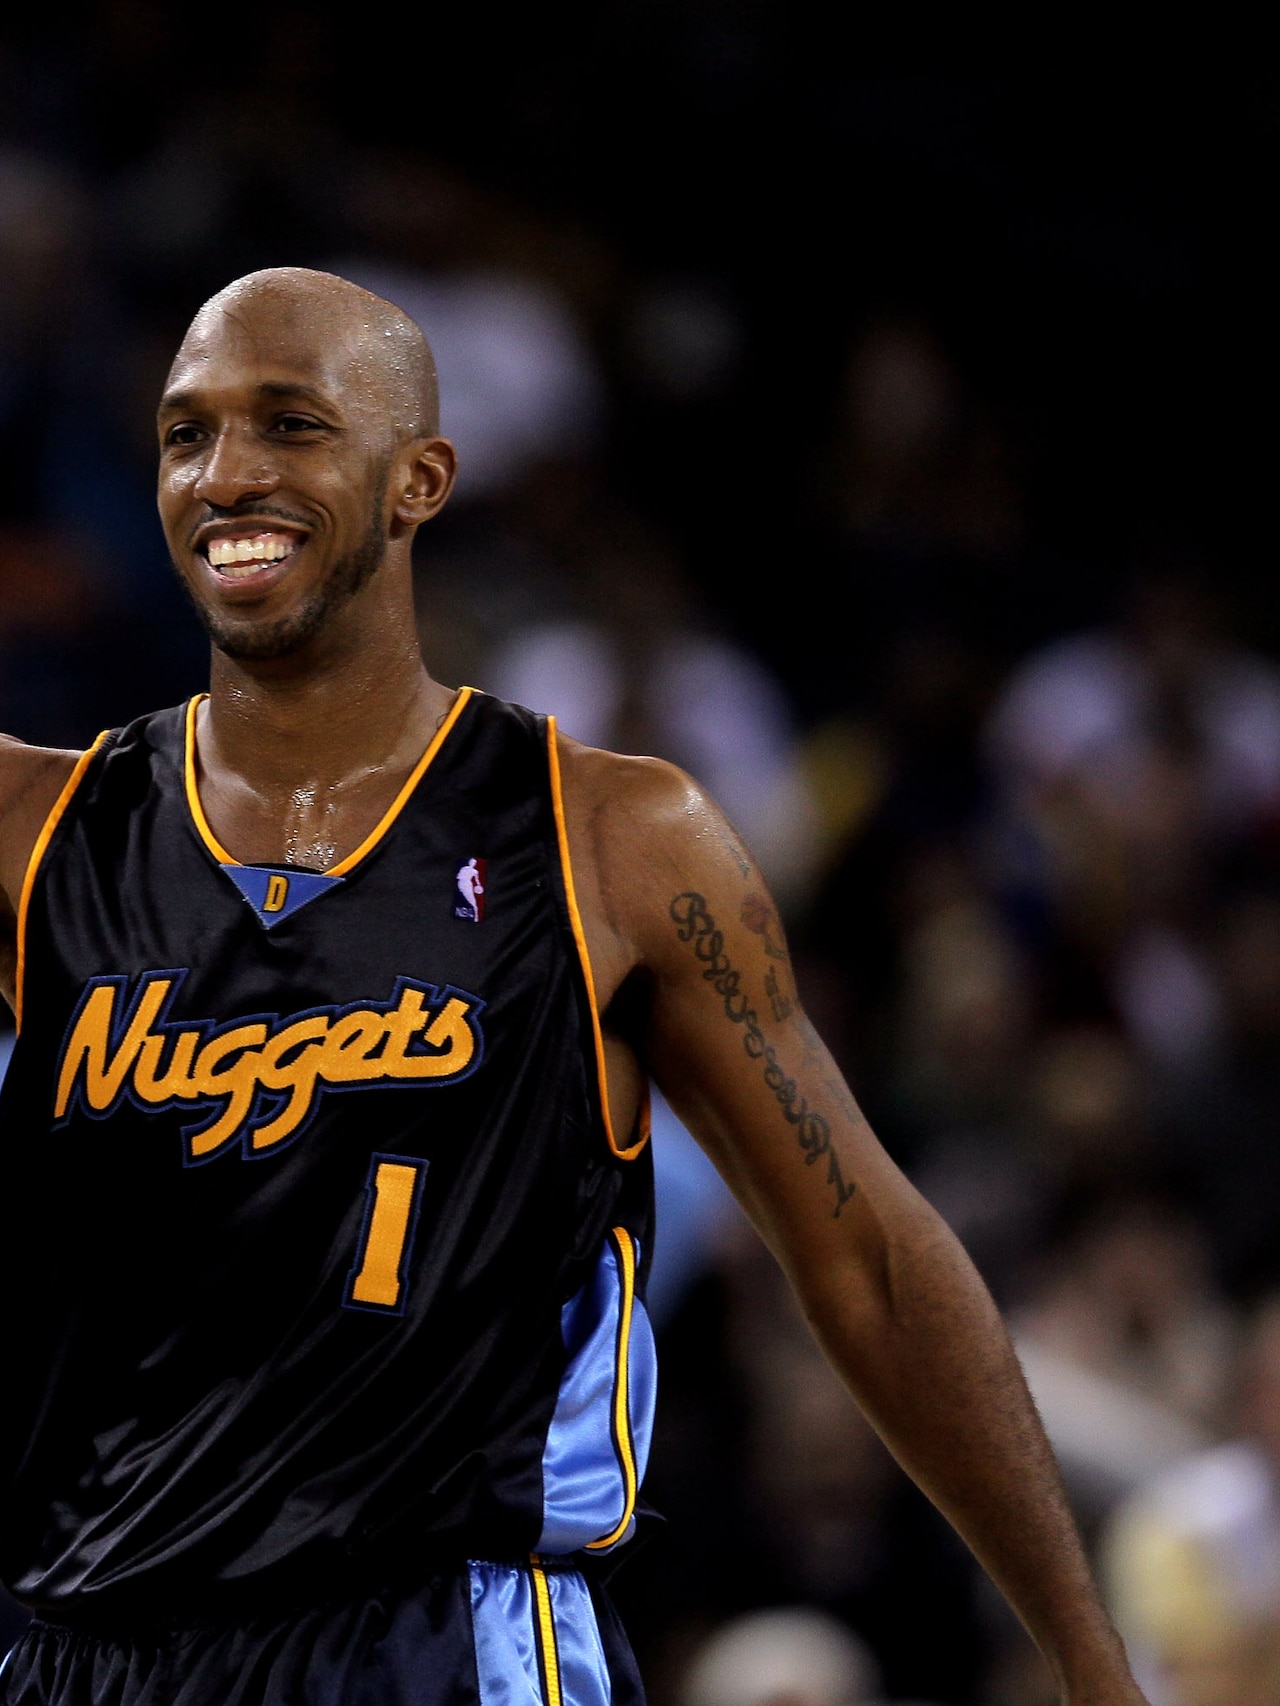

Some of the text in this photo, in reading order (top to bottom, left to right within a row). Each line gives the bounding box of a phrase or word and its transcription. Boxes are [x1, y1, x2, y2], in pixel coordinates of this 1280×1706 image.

[261, 874, 289, 912] D
[50, 970, 484, 1164] Nuggets
[347, 1157, 423, 1311] 1
